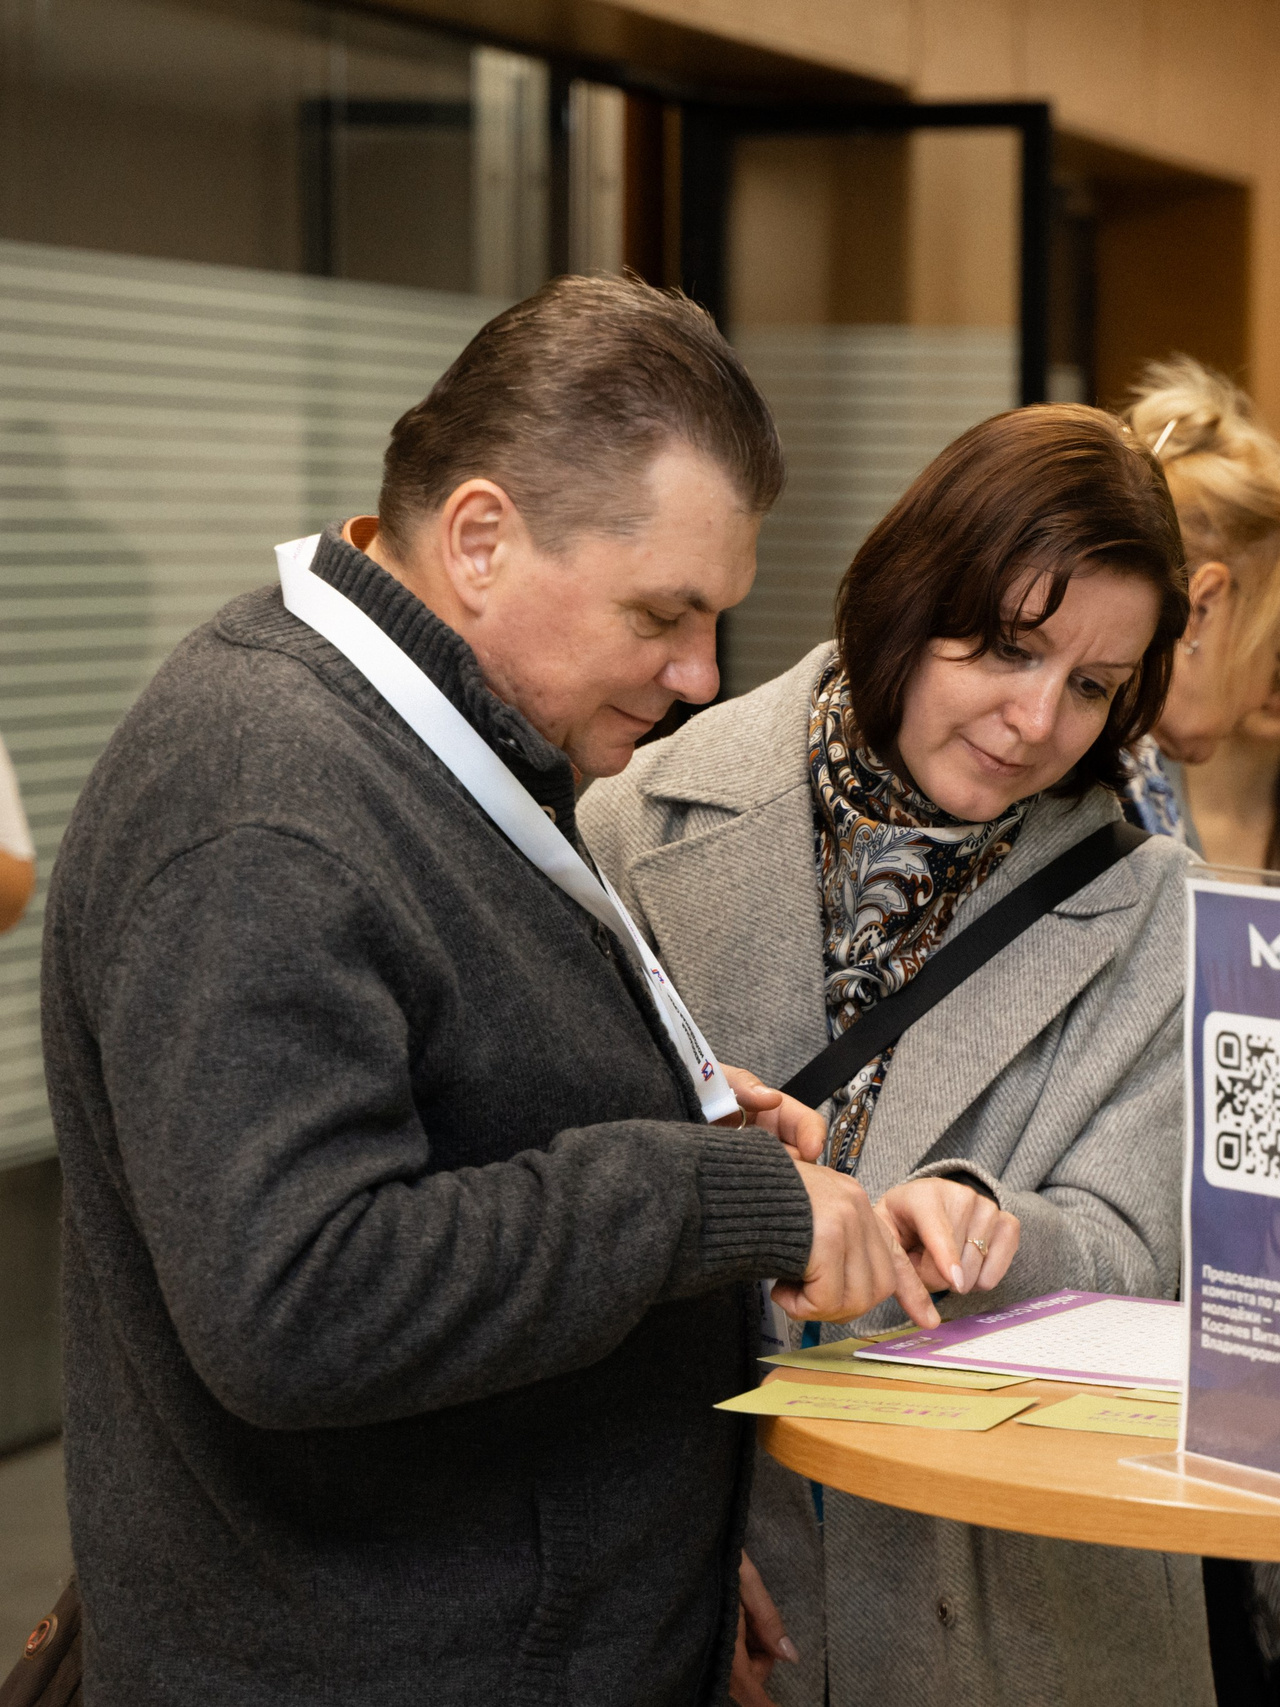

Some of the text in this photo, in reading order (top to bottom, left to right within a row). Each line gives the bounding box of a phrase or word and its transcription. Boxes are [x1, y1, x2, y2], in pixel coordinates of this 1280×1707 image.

[1201, 1284, 1257, 1307] комитета
[1257, 1295, 1273, 1310] по
[1201, 1301, 1262, 1324] молодёжи
